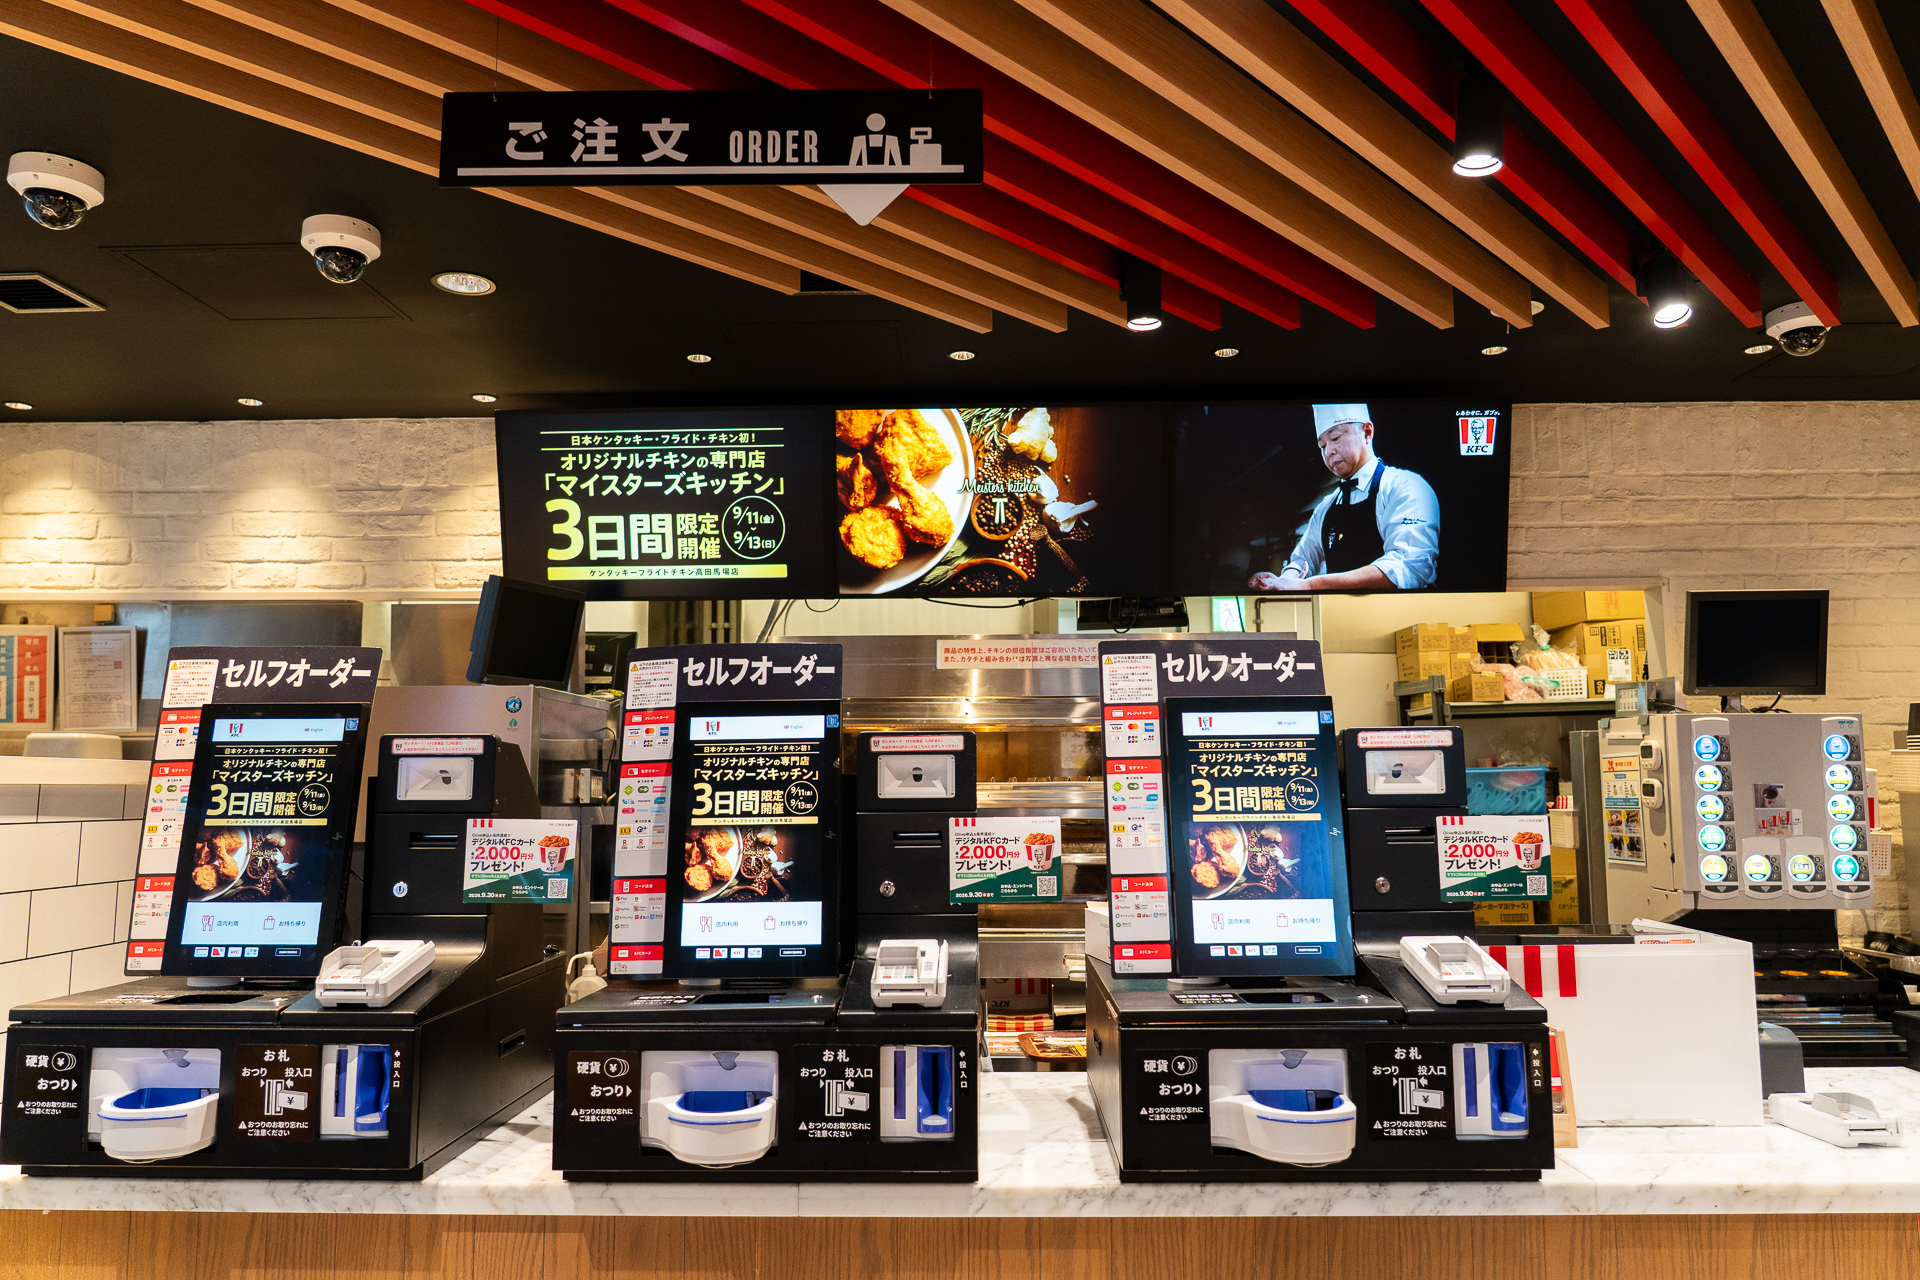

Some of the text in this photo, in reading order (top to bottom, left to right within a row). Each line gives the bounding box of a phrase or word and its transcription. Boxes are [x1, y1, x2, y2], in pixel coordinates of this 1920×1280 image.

[505, 117, 820, 164] ご注文 ORDER
[1466, 445, 1489, 454] KFC
[560, 450, 766, 471] オリジナルチキンの専門店
[545, 471, 785, 497] 「マイスターズキッチン」
[958, 478, 1041, 494] Meisters kitchen
[545, 498, 673, 561] 3日間
[676, 513, 720, 536] 限定
[677, 537, 722, 560] 開催
[589, 567, 740, 578] ケンタッキーフライドチキン高田馬場店
[221, 657, 372, 689] セルフオーダー
[682, 653, 835, 687] セルフオーダー
[1161, 650, 1316, 683] セルフオーダー
[1596, 681, 1604, 694] 250
[222, 758, 326, 769] オリジナルチキンの専門店
[703, 756, 810, 767] オリジナルチキンの専門店
[1198, 752, 1307, 763] オリジナルチキンの専門店
[211, 769, 334, 784] 「マイスターズキッチン」
[693, 768, 819, 781] 「マイスターズキッチン」
[1190, 763, 1318, 777] 「マイスターズキッチン」
[273, 792, 297, 804] 限定
[760, 789, 784, 802] 限定
[1192, 778, 1261, 812] 3日間
[1260, 785, 1285, 798] 限定
[206, 783, 273, 816] 3日間
[691, 782, 760, 816] 3日間
[1261, 798, 1286, 811] 開催
[273, 803, 297, 816] 開催
[760, 802, 784, 815] 開催
[471, 838, 536, 846] デジタルKFCカード
[954, 836, 1021, 845] デジタルKFCカード
[1443, 835, 1509, 844] デジタルKFCカード
[474, 846, 534, 861] 2,000円分
[959, 845, 1021, 860] 2,000円分
[1448, 844, 1510, 859] 2,000円分
[263, 1049, 290, 1062] お札
[822, 1049, 850, 1063] お札
[1393, 1046, 1422, 1060] お札
[26, 1055, 49, 1068] 硬貨
[576, 1061, 601, 1075] 硬貨
[1143, 1059, 1169, 1073] 硬貨
[241, 1066, 268, 1078] おつり
[284, 1066, 313, 1078] 投入口
[393, 1060, 401, 1088] 投入口
[800, 1067, 827, 1078] おつり
[845, 1067, 873, 1078] 投入口
[959, 1060, 968, 1089] 投入口
[1372, 1065, 1400, 1076] おつり
[1417, 1065, 1447, 1076] 投入口
[1532, 1058, 1542, 1087] 投入口
[36, 1077, 70, 1092] おつり
[590, 1084, 624, 1098] おつり
[1158, 1082, 1194, 1096] おつり
[25, 1100, 78, 1109] おつりのお取り忘れに
[1148, 1106, 1204, 1114] おつりのお取り忘れに
[24, 1108, 62, 1116] ご注意ください
[578, 1108, 634, 1116] おつりのお取り忘れに
[1148, 1113, 1188, 1121] ご注意ください
[247, 1120, 309, 1129] おつりのお取り忘れに
[807, 1121, 872, 1130] おつりのお取り忘れに
[1382, 1119, 1447, 1129] おつりのお取り忘れに
[247, 1129, 291, 1137] ご注意ください
[807, 1129, 853, 1138] ご注意ください
[1382, 1128, 1429, 1137] ご注意ください
